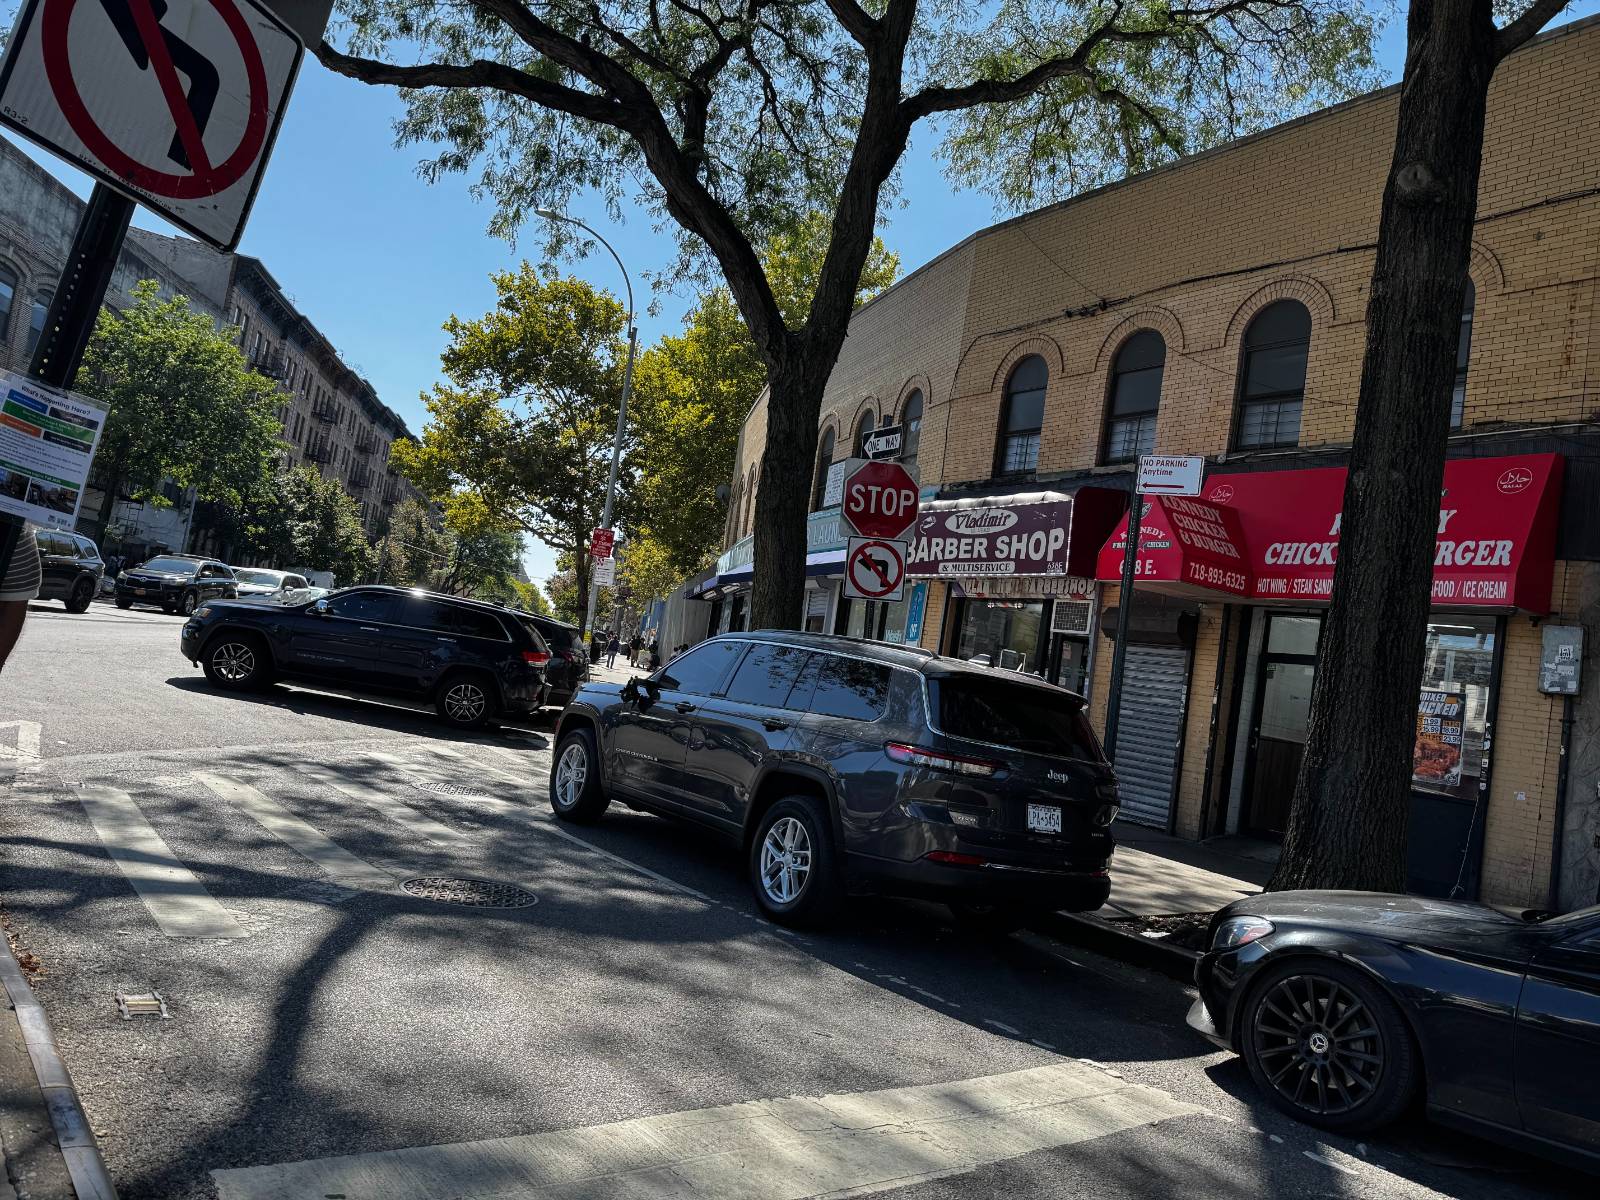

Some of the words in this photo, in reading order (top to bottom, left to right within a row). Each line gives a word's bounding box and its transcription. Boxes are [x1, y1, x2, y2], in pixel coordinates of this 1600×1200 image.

[4, 106, 29, 125] R3-2
[868, 439, 880, 452] ONE
[885, 435, 899, 449] WAY
[1143, 459, 1154, 467] NO
[1156, 459, 1188, 468] PARKING
[1143, 468, 1173, 476] Anytime
[849, 483, 915, 517] STOP
[955, 508, 1011, 530] Vladimir
[1160, 496, 1224, 524] KENNEDY
[1119, 526, 1166, 540] KNEDY
[1172, 512, 1230, 540] CHICKEN
[907, 534, 988, 565] BARBER
[994, 527, 1065, 561] SHOP
[1179, 529, 1190, 544] &
[1191, 532, 1241, 559] BURGER
[1264, 541, 1340, 565] CHICK
[1433, 540, 1514, 567] RGER
[942, 564, 949, 572] &
[951, 562, 1011, 572] MULTISERVICE
[1119, 560, 1142, 575] 68
[1189, 562, 1246, 591] 718-893-6325
[1256, 577, 1270, 593] HOT
[1270, 578, 1287, 594] WING
[1293, 578, 1314, 594] STEAK
[1463, 580, 1477, 598] ICE
[1477, 581, 1508, 599] CREAM
[1047, 769, 1069, 784] Jeep
